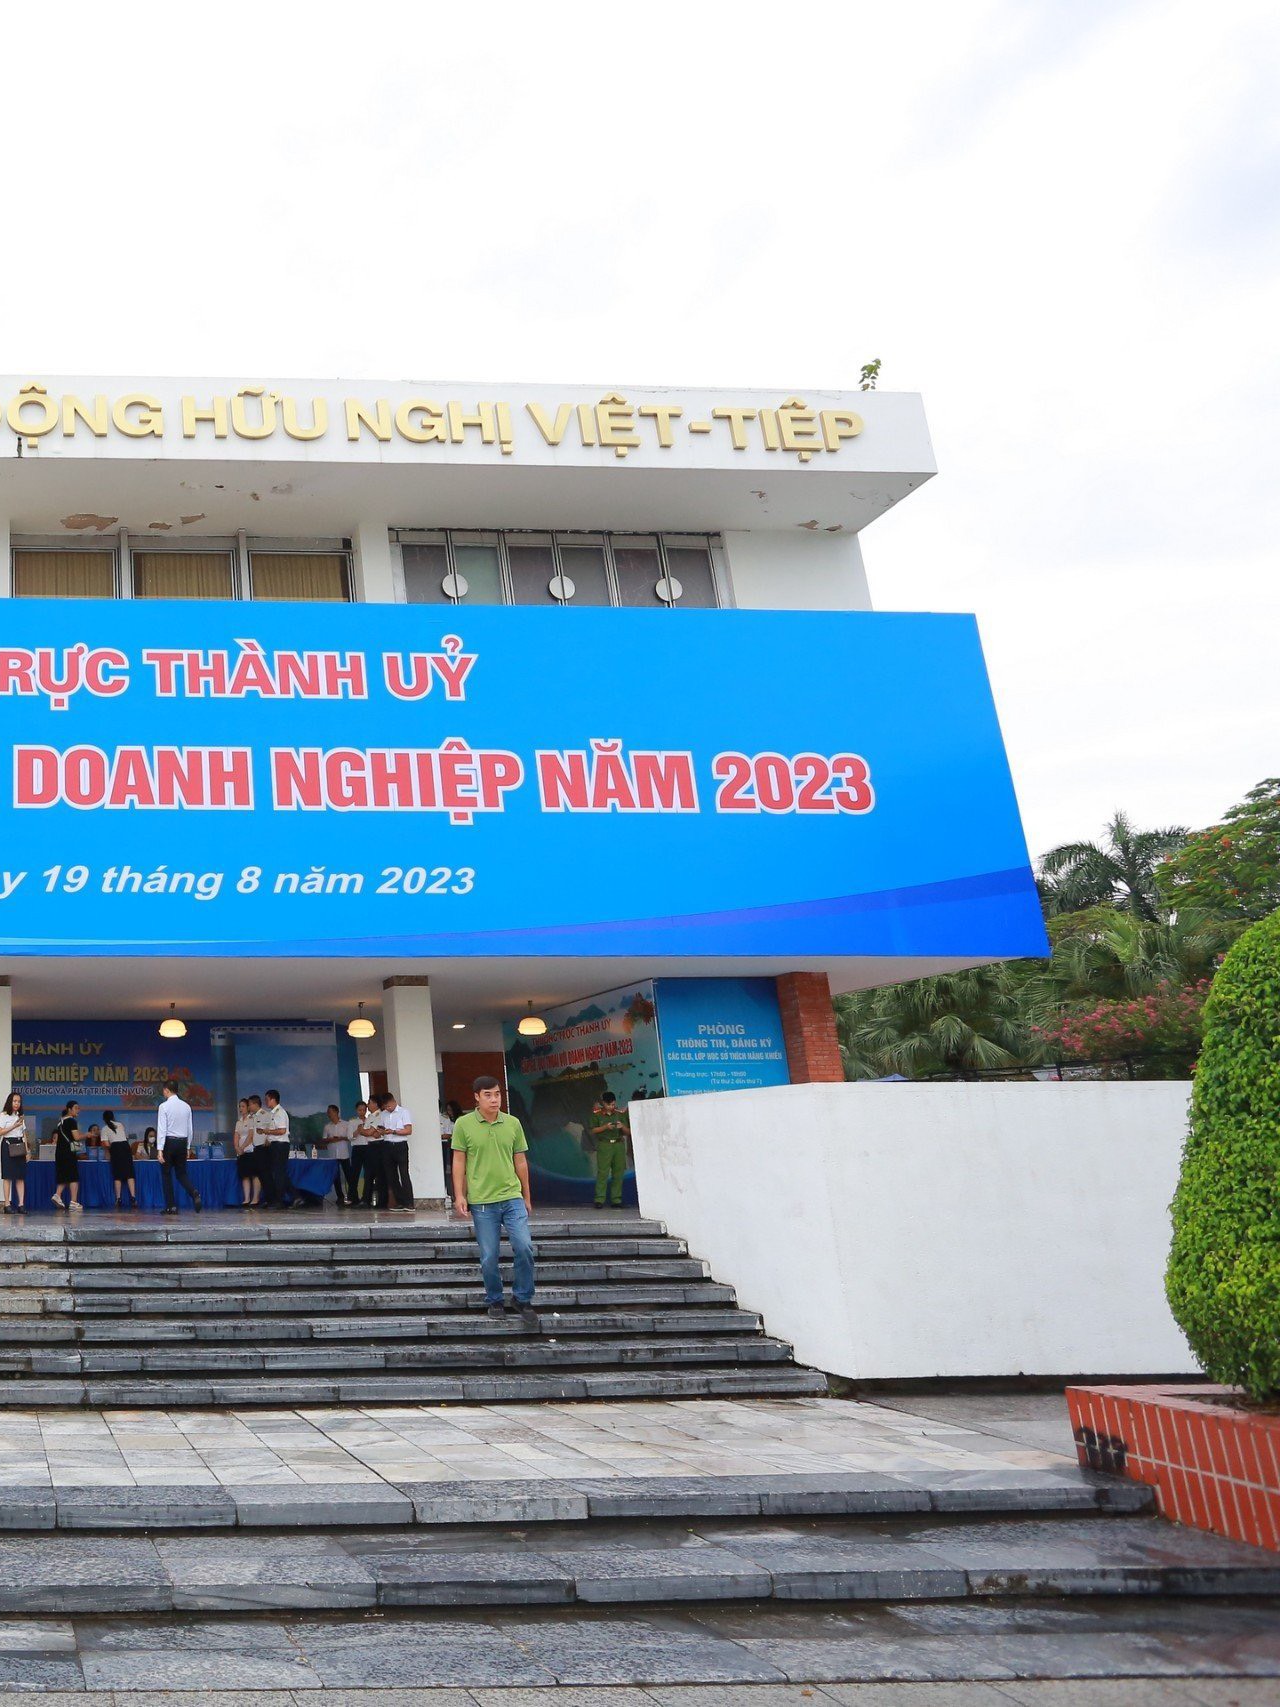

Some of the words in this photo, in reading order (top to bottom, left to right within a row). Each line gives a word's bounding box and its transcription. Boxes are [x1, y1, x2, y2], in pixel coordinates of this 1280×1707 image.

[182, 388, 332, 442] HỮU
[344, 397, 515, 457] NGHỊ
[143, 638, 368, 699] THÀNH
[382, 634, 479, 701] UỶ
[13, 744, 254, 810] DOANH
[270, 736, 524, 826] NGHIỆP
[535, 738, 700, 813] NĂM
[712, 751, 875, 815] 2023
[41, 864, 89, 893] 19
[102, 865, 224, 901] tháng
[237, 866, 262, 894] 8
[273, 866, 364, 894] năm
[375, 867, 476, 895] 2023
[676, 1037, 708, 1048] THÔNG
[698, 1022, 745, 1035] PHÒNG
[12, 1040, 73, 1055] THÀNH
[35, 1062, 89, 1085] NGHIỆP
[93, 1062, 128, 1082] NĂM
[133, 1066, 169, 1082] 2023
